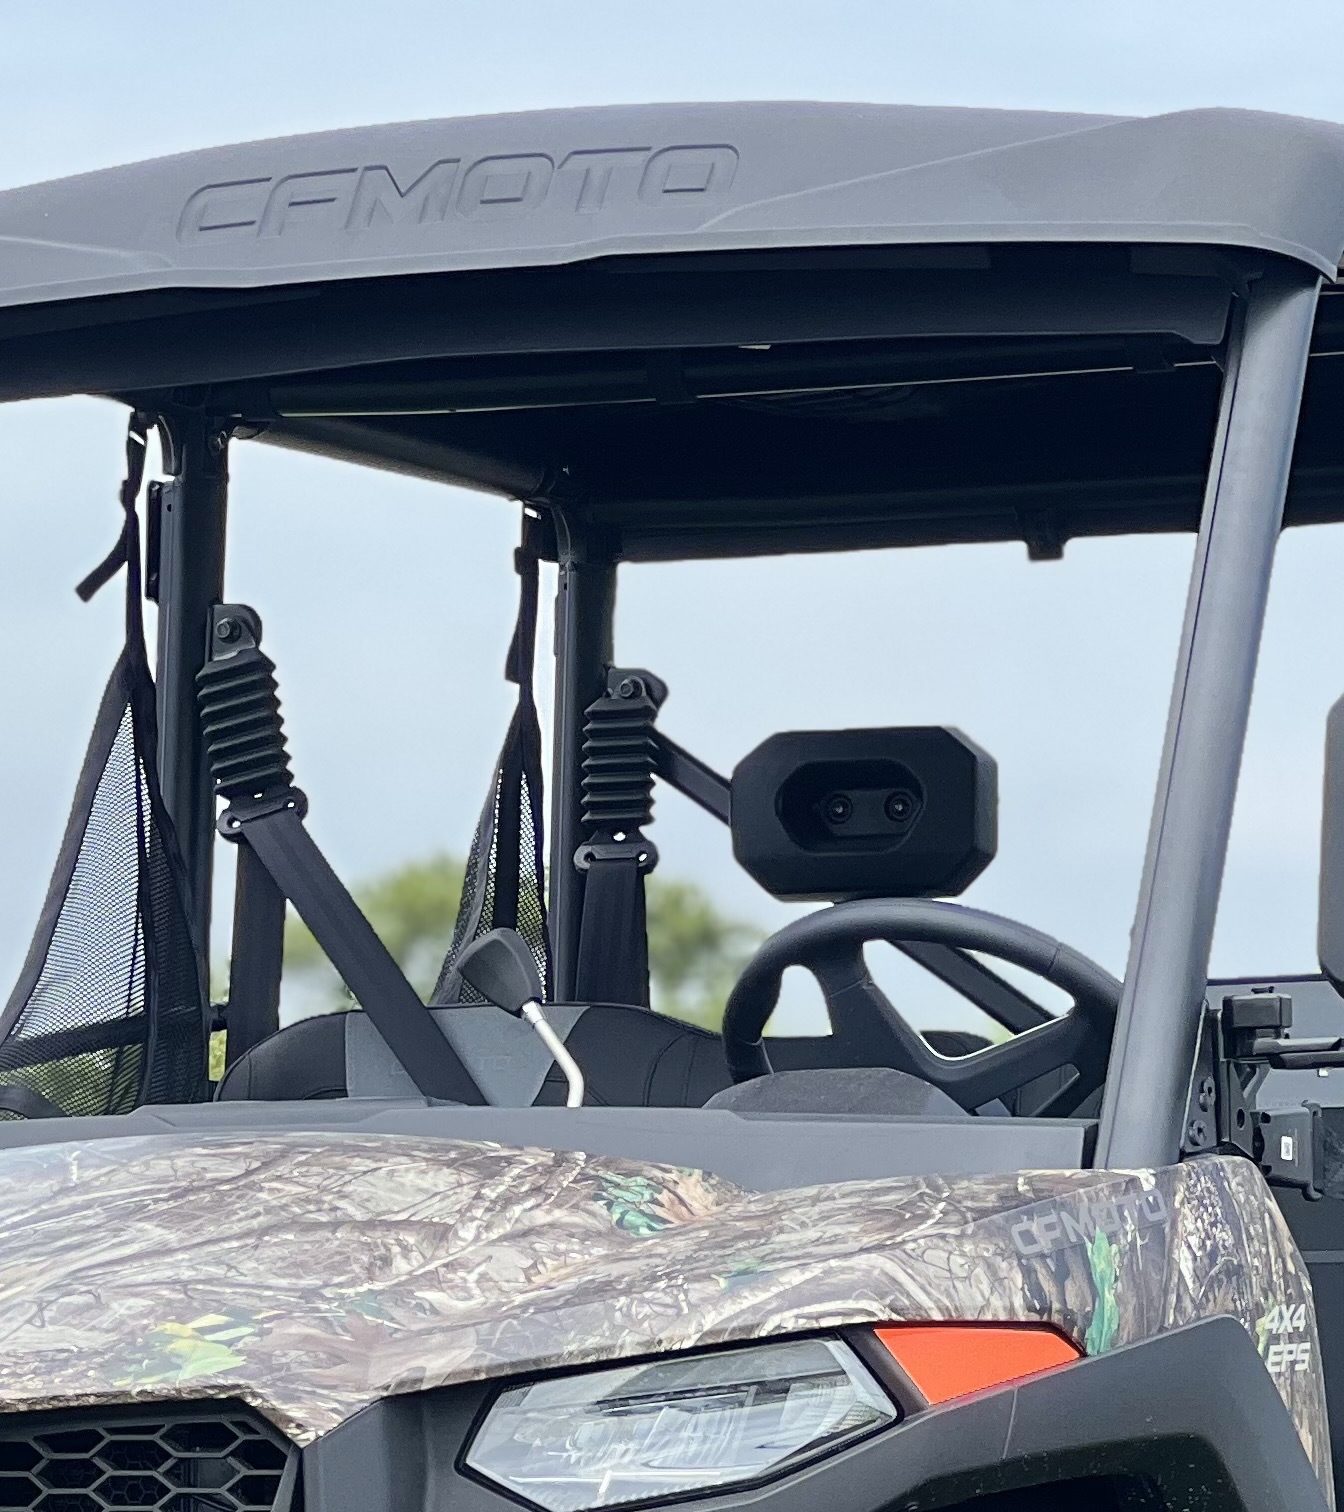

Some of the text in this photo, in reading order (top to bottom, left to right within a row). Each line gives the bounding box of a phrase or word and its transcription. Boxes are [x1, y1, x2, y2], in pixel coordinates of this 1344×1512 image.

[176, 143, 740, 244] CFMOTO
[1265, 1303, 1307, 1335] 4X4
[1267, 1341, 1311, 1374] EPS
